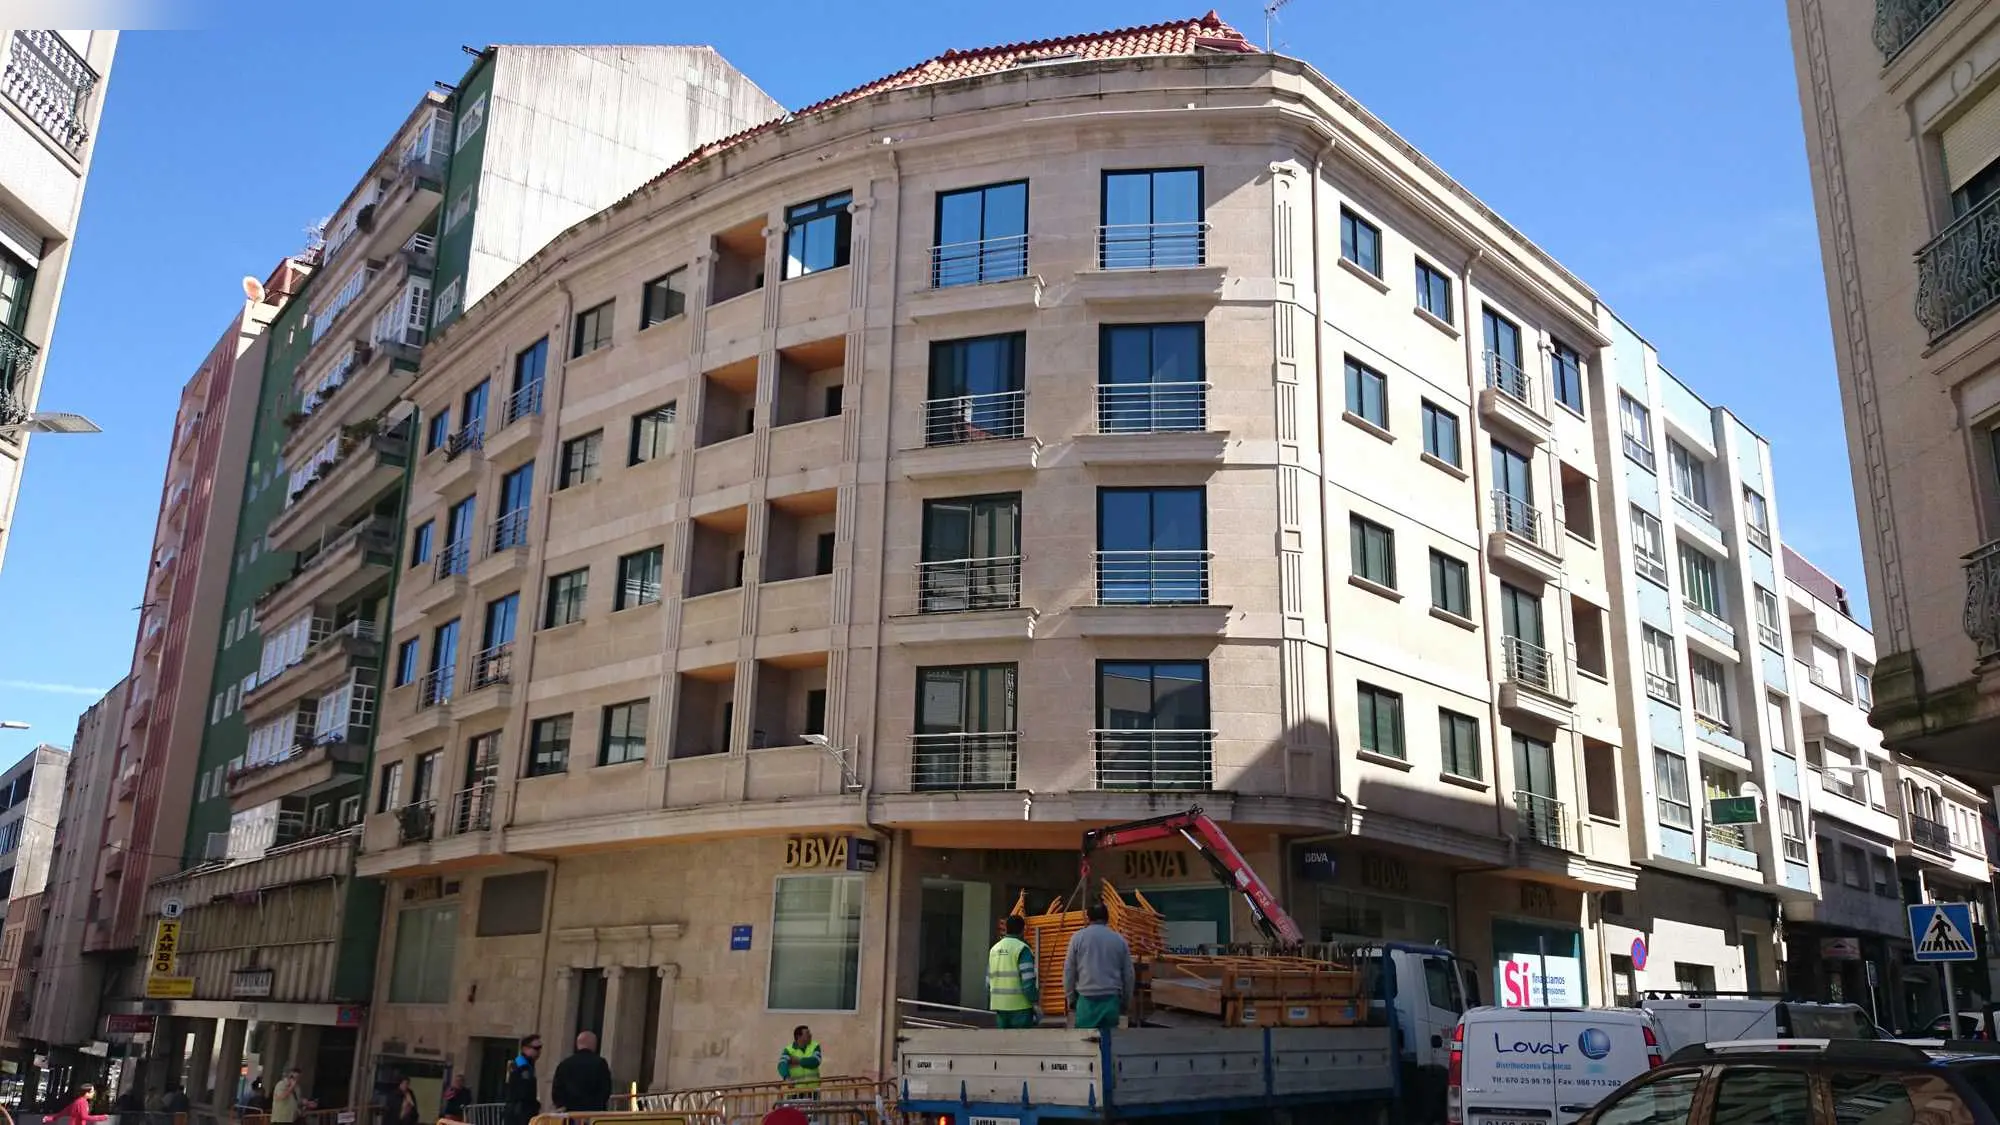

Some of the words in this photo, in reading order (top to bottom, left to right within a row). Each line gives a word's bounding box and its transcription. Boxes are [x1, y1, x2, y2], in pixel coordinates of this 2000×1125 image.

[786, 837, 848, 868] BBVA
[1124, 850, 1185, 878] BBVA
[155, 923, 176, 972] TAMBO
[1494, 1032, 1569, 1054] Lovar
